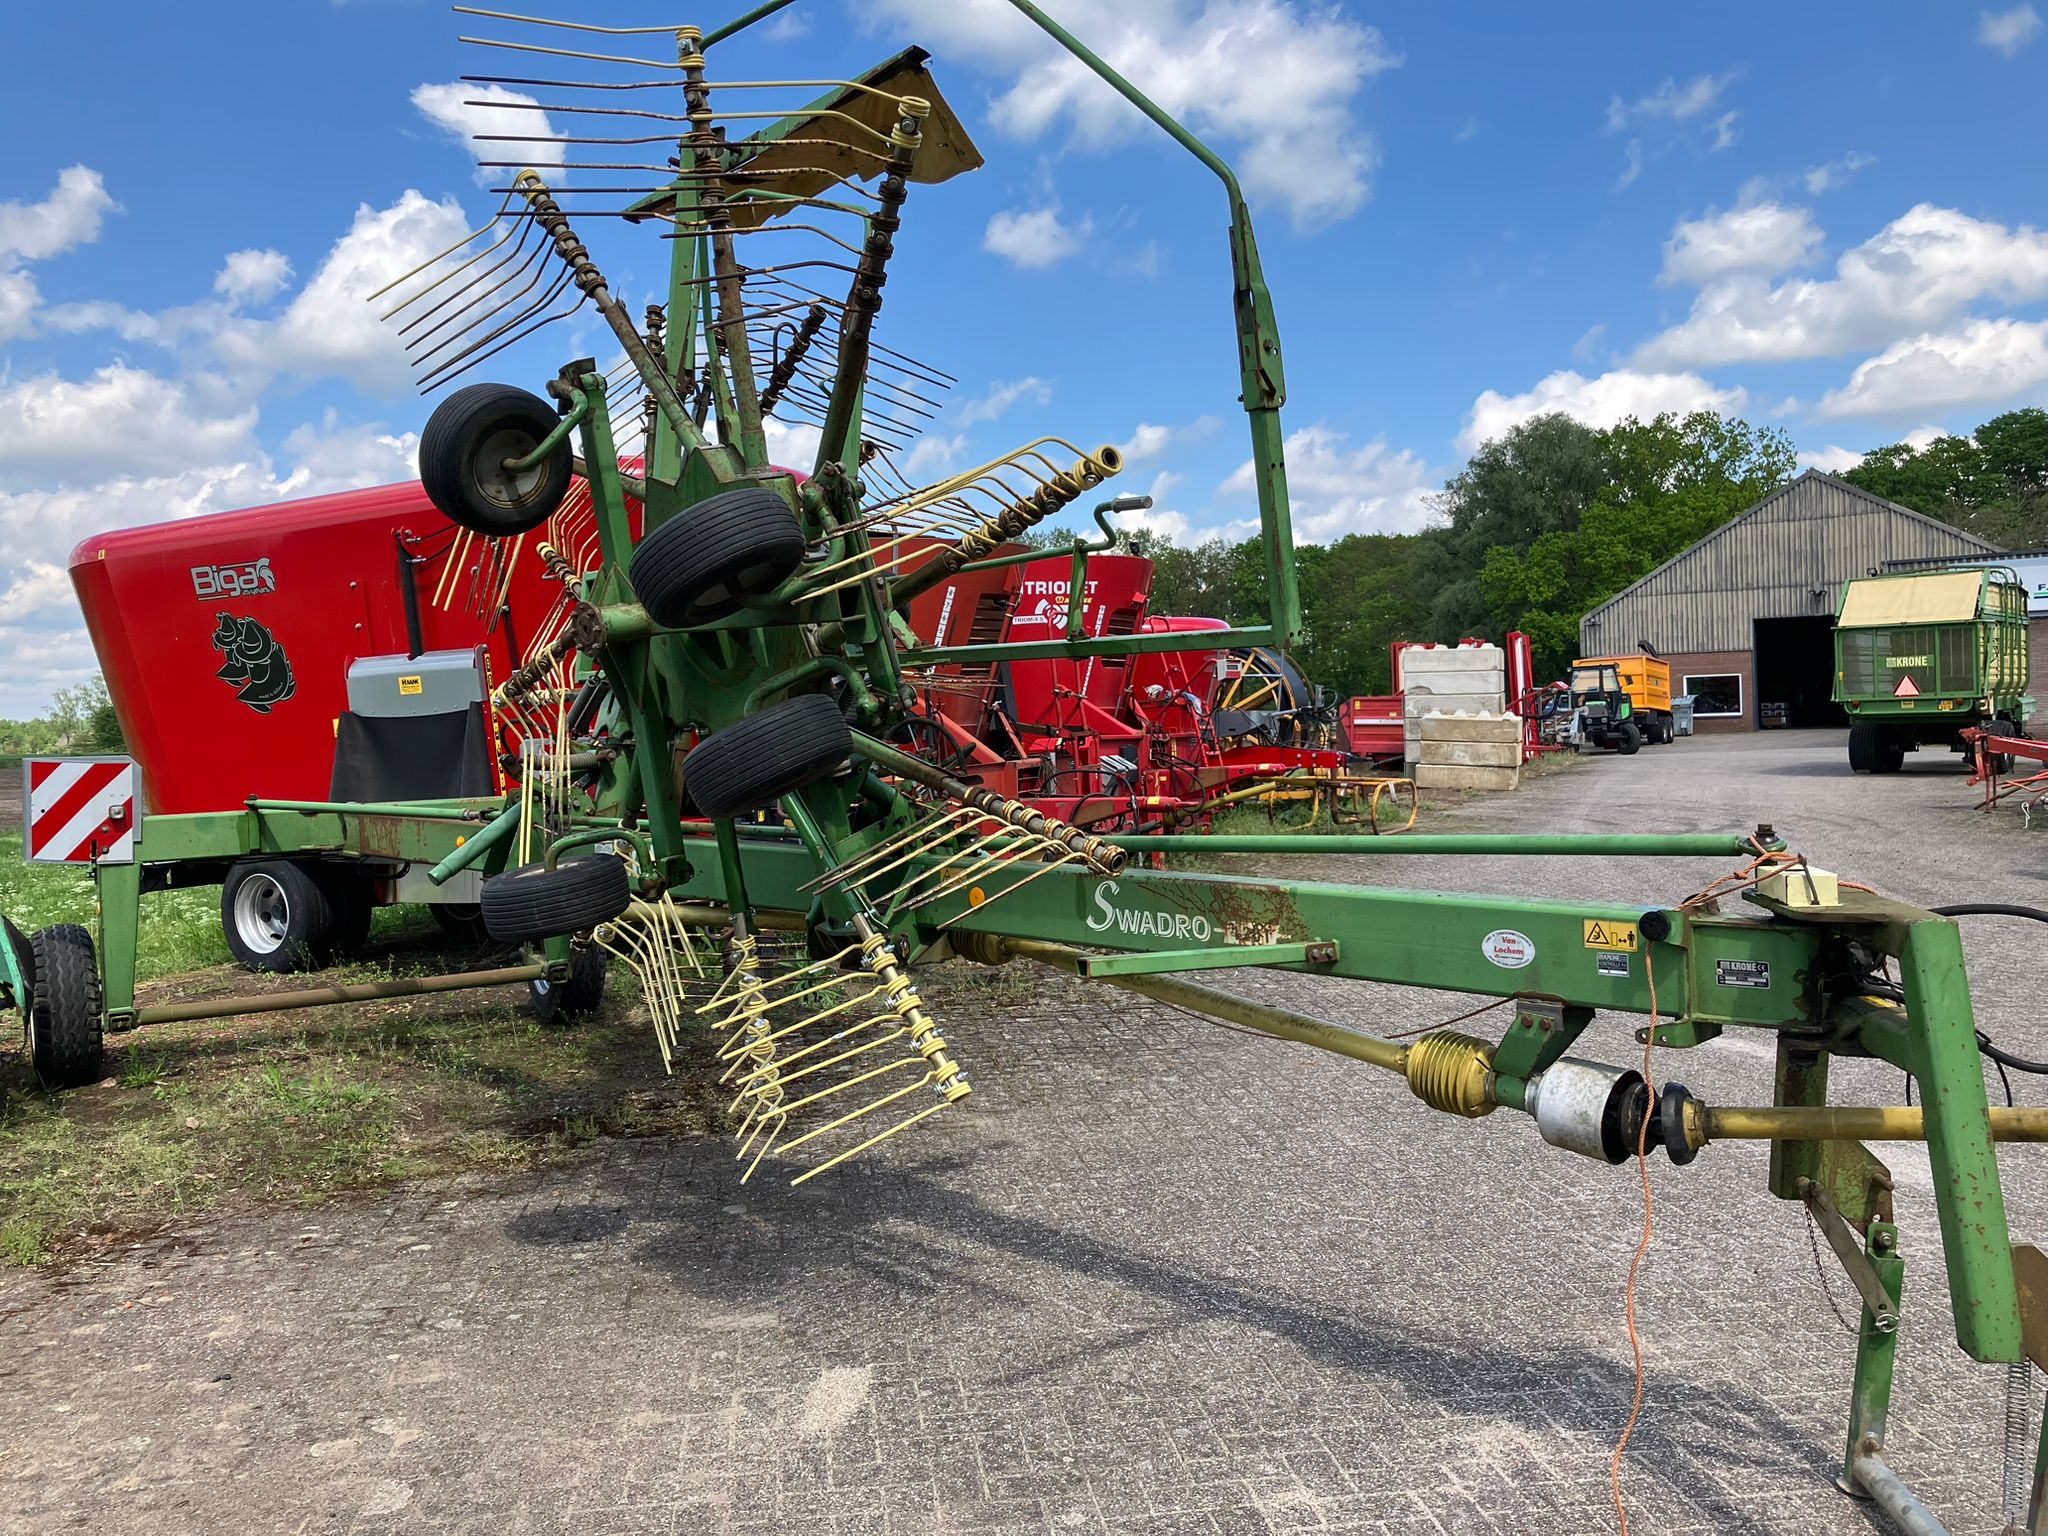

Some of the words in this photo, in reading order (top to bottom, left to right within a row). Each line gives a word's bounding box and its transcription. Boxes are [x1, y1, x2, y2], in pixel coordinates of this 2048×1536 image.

[190, 565, 258, 597] Biga
[1896, 656, 1928, 667] KRONE
[1086, 880, 1211, 942] SWADRO
[1501, 936, 1516, 944] Van
[1494, 945, 1524, 955] Lochem
[1731, 962, 1757, 971] KRONE
